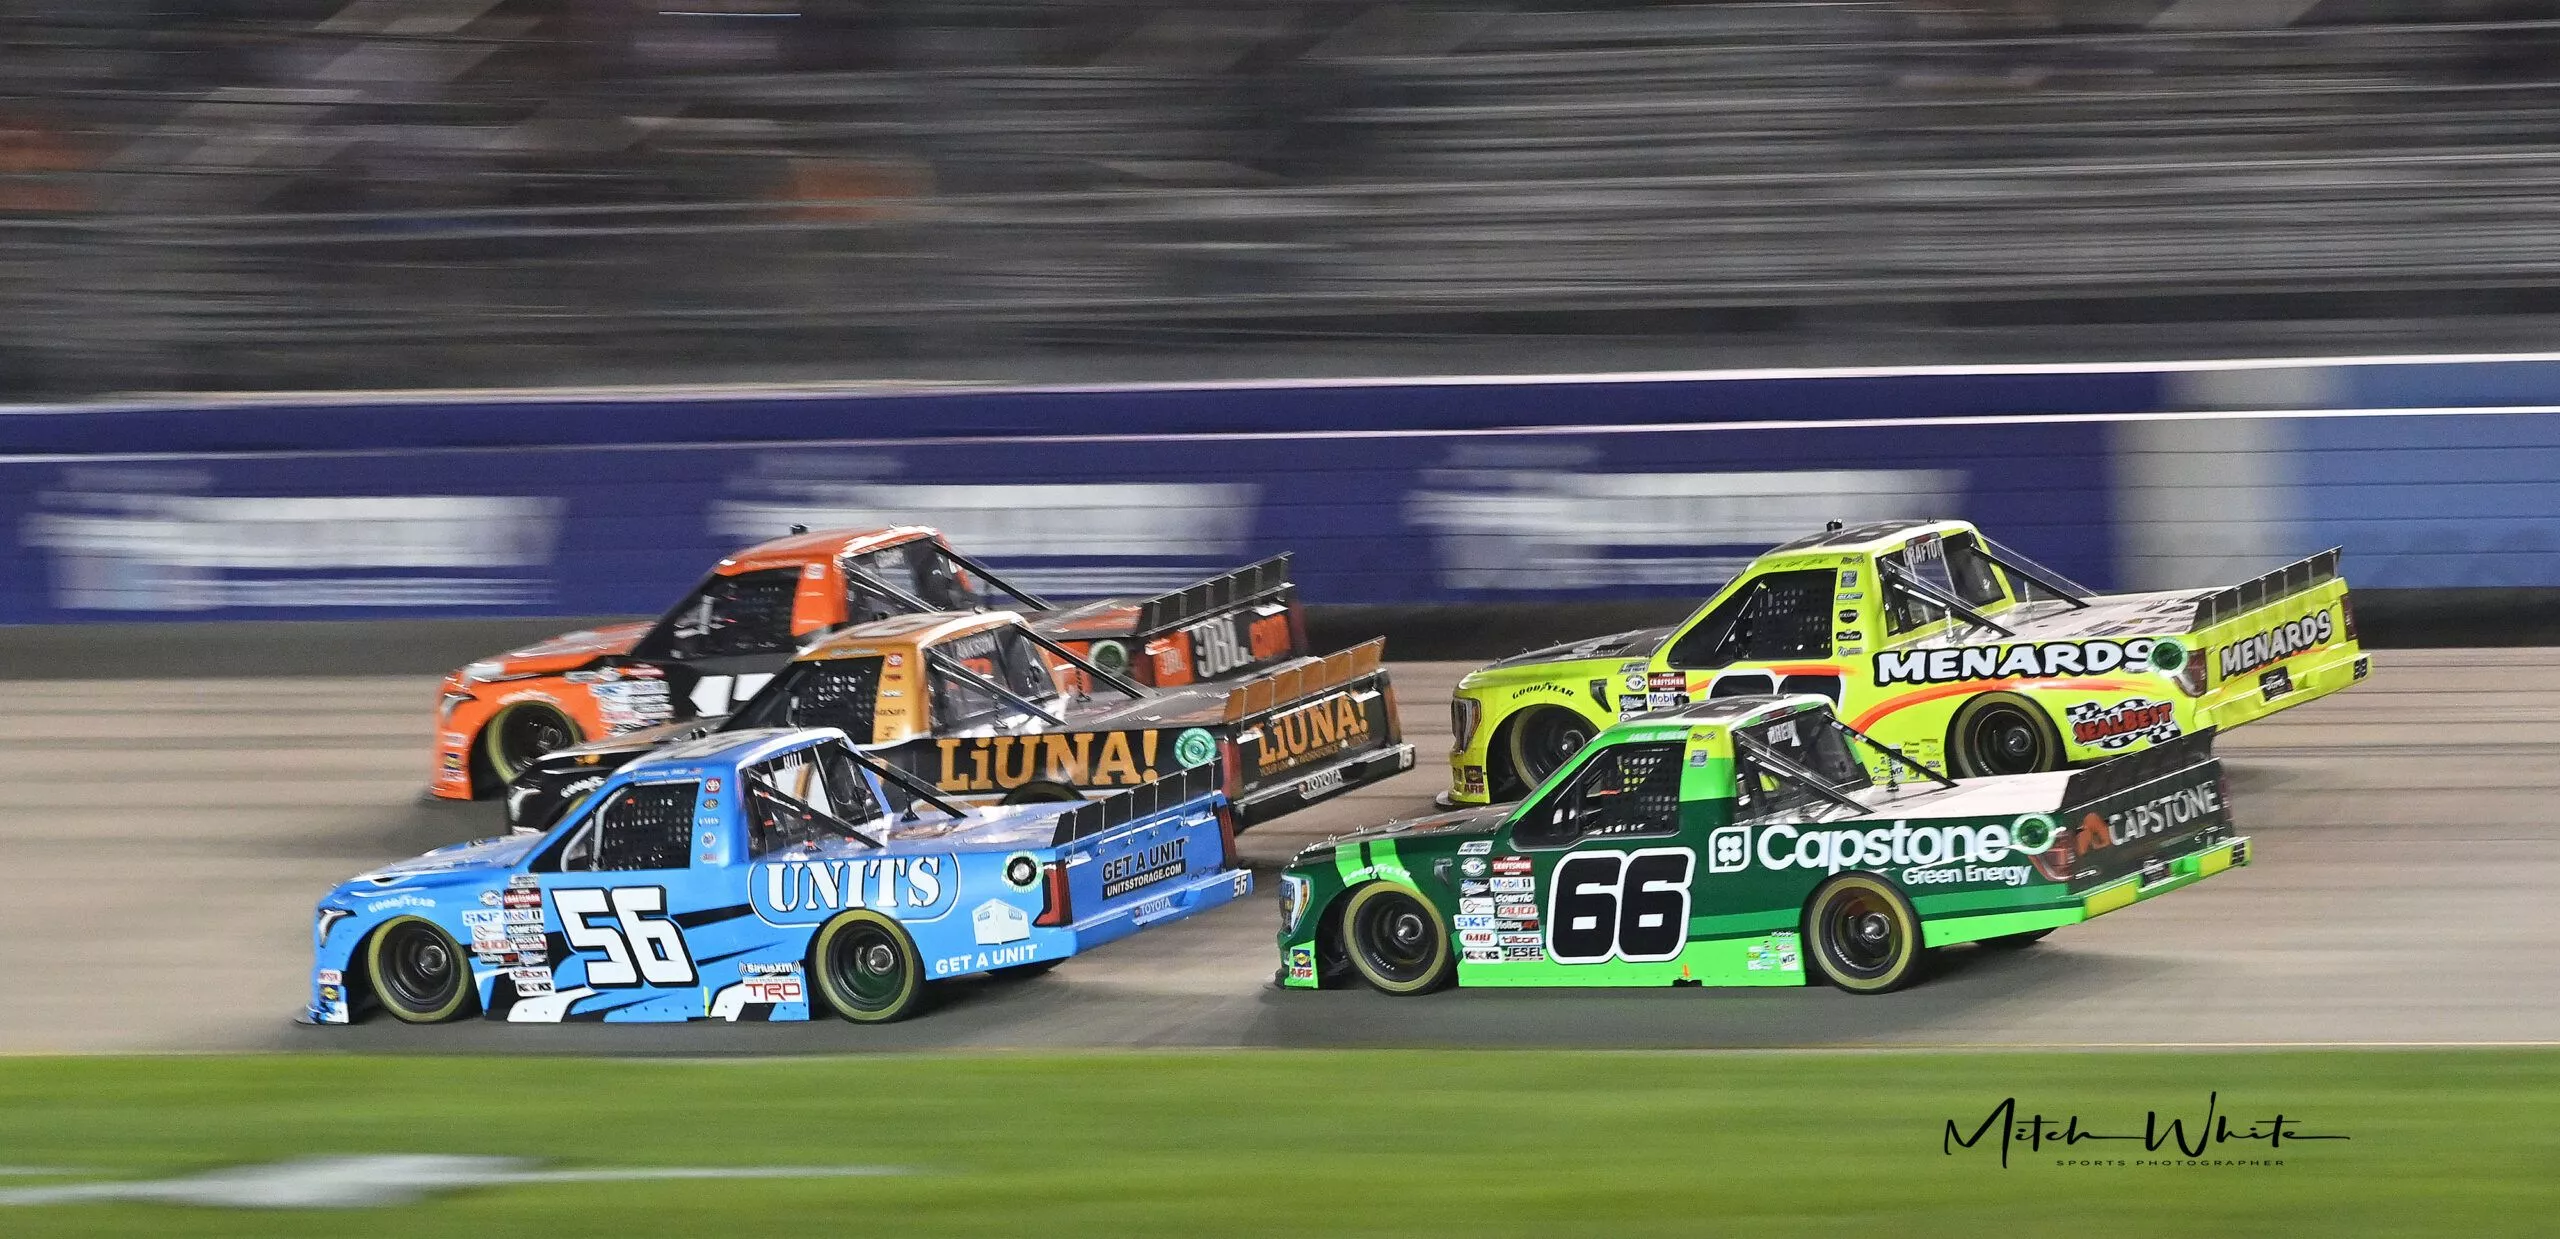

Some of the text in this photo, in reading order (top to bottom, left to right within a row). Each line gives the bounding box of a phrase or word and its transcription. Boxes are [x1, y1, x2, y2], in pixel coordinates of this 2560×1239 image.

[2220, 609, 2332, 682] MENARDS
[1874, 638, 2153, 687] MENARDS
[1650, 677, 1684, 686] CRAFTSMAN
[1258, 695, 1369, 767] LiUNA!
[936, 729, 1159, 791] LiUNA!
[1307, 769, 1343, 791] TOYOTA
[2109, 780, 2221, 846] CAPSTONE
[1102, 839, 1186, 881] GET A UNIT
[1757, 820, 2011, 876] Capstone
[765, 857, 942, 912] UNITS
[1106, 863, 1182, 897] UNITSSTORAGE.COM
[1232, 874, 1248, 898] 56
[1494, 880, 1521, 888] Mobil
[1902, 862, 2033, 885] Green Energy
[465, 912, 500, 924] SKF
[1140, 898, 1171, 914] TOYOTA
[1547, 847, 1696, 964] 66
[551, 885, 699, 990] 56
[1458, 917, 1491, 927] SKF
[936, 944, 1038, 975] GET A UNIT
[1504, 946, 1543, 957] JESEL
[744, 983, 801, 1001] TRD
